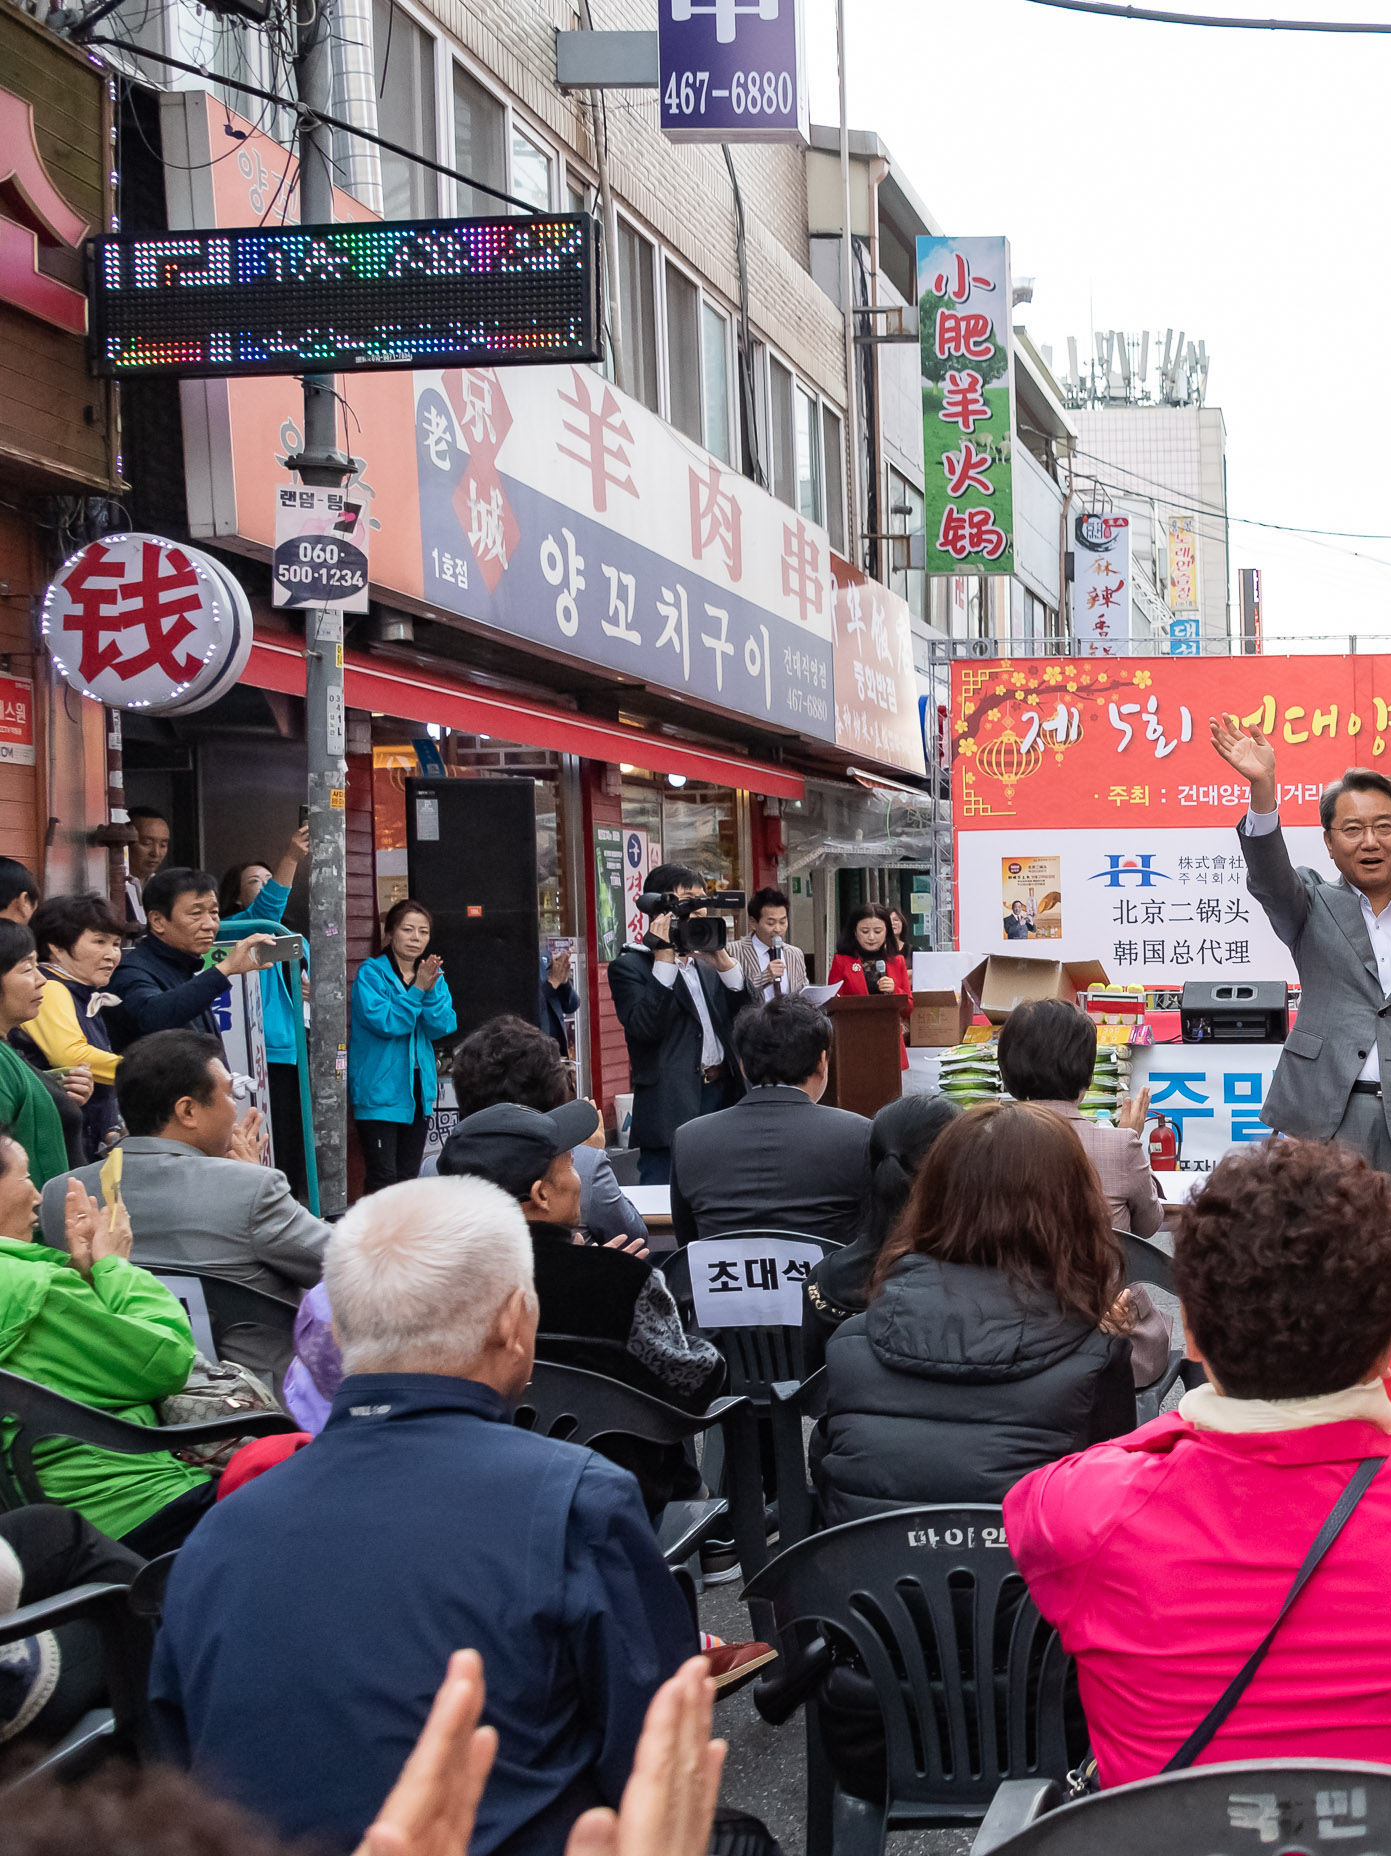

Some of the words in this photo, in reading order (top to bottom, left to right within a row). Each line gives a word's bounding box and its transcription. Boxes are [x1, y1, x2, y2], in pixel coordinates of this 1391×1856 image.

[664, 71, 793, 116] 467-6880
[929, 252, 1008, 558] 小肥羊火锅
[556, 364, 824, 622] 羊肉串
[431, 547, 469, 591] 1호점
[62, 538, 204, 685] 钱
[540, 527, 772, 711] 양꼬치구이
[786, 686, 829, 724] 467-6880
[1020, 703, 1081, 754] 제
[1108, 695, 1193, 759] 5회
[1108, 784, 1150, 807] 주최
[1112, 898, 1250, 925] 北京二锅头
[1113, 939, 1251, 966] 韩国总代理
